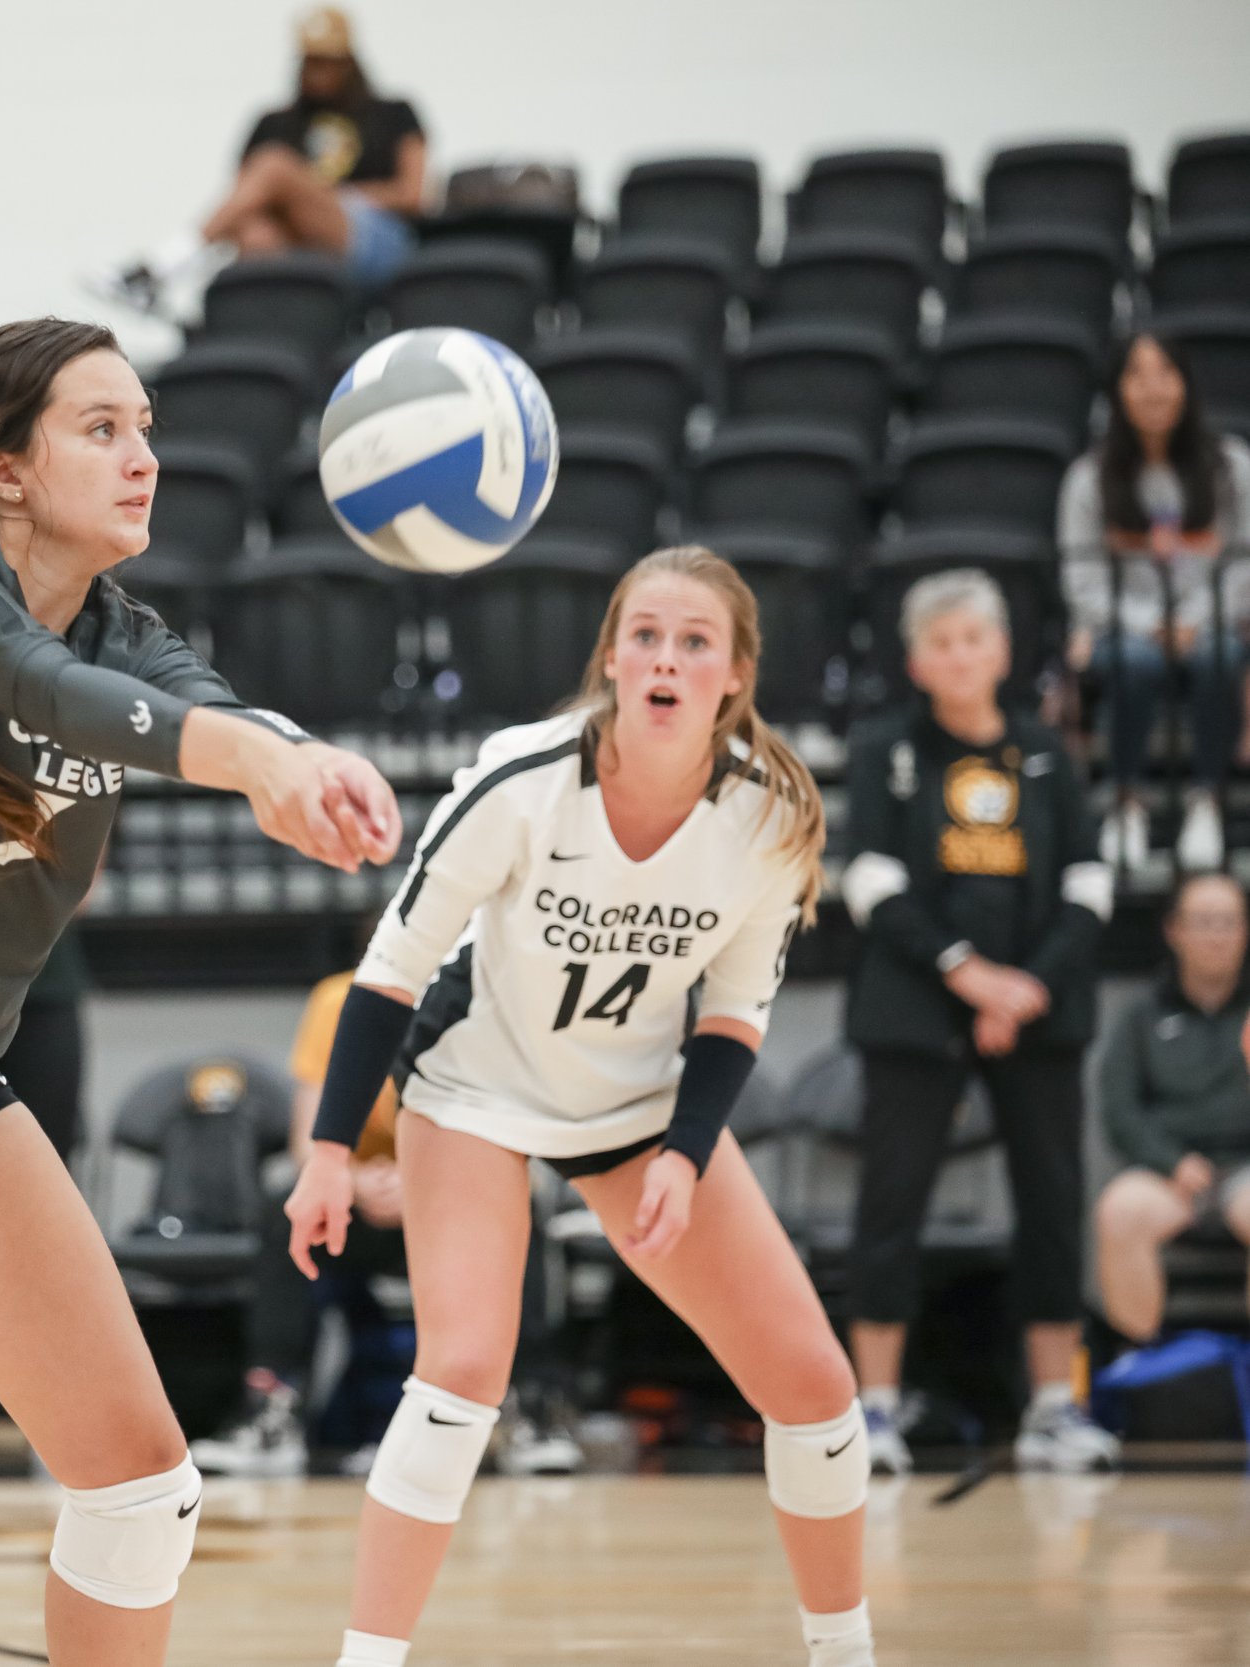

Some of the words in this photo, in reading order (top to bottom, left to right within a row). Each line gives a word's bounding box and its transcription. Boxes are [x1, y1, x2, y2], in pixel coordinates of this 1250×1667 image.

[34, 750, 124, 798] LEGE
[535, 888, 720, 931] COLORADO
[543, 924, 694, 957] COLLEGE
[552, 961, 652, 1032] 14
